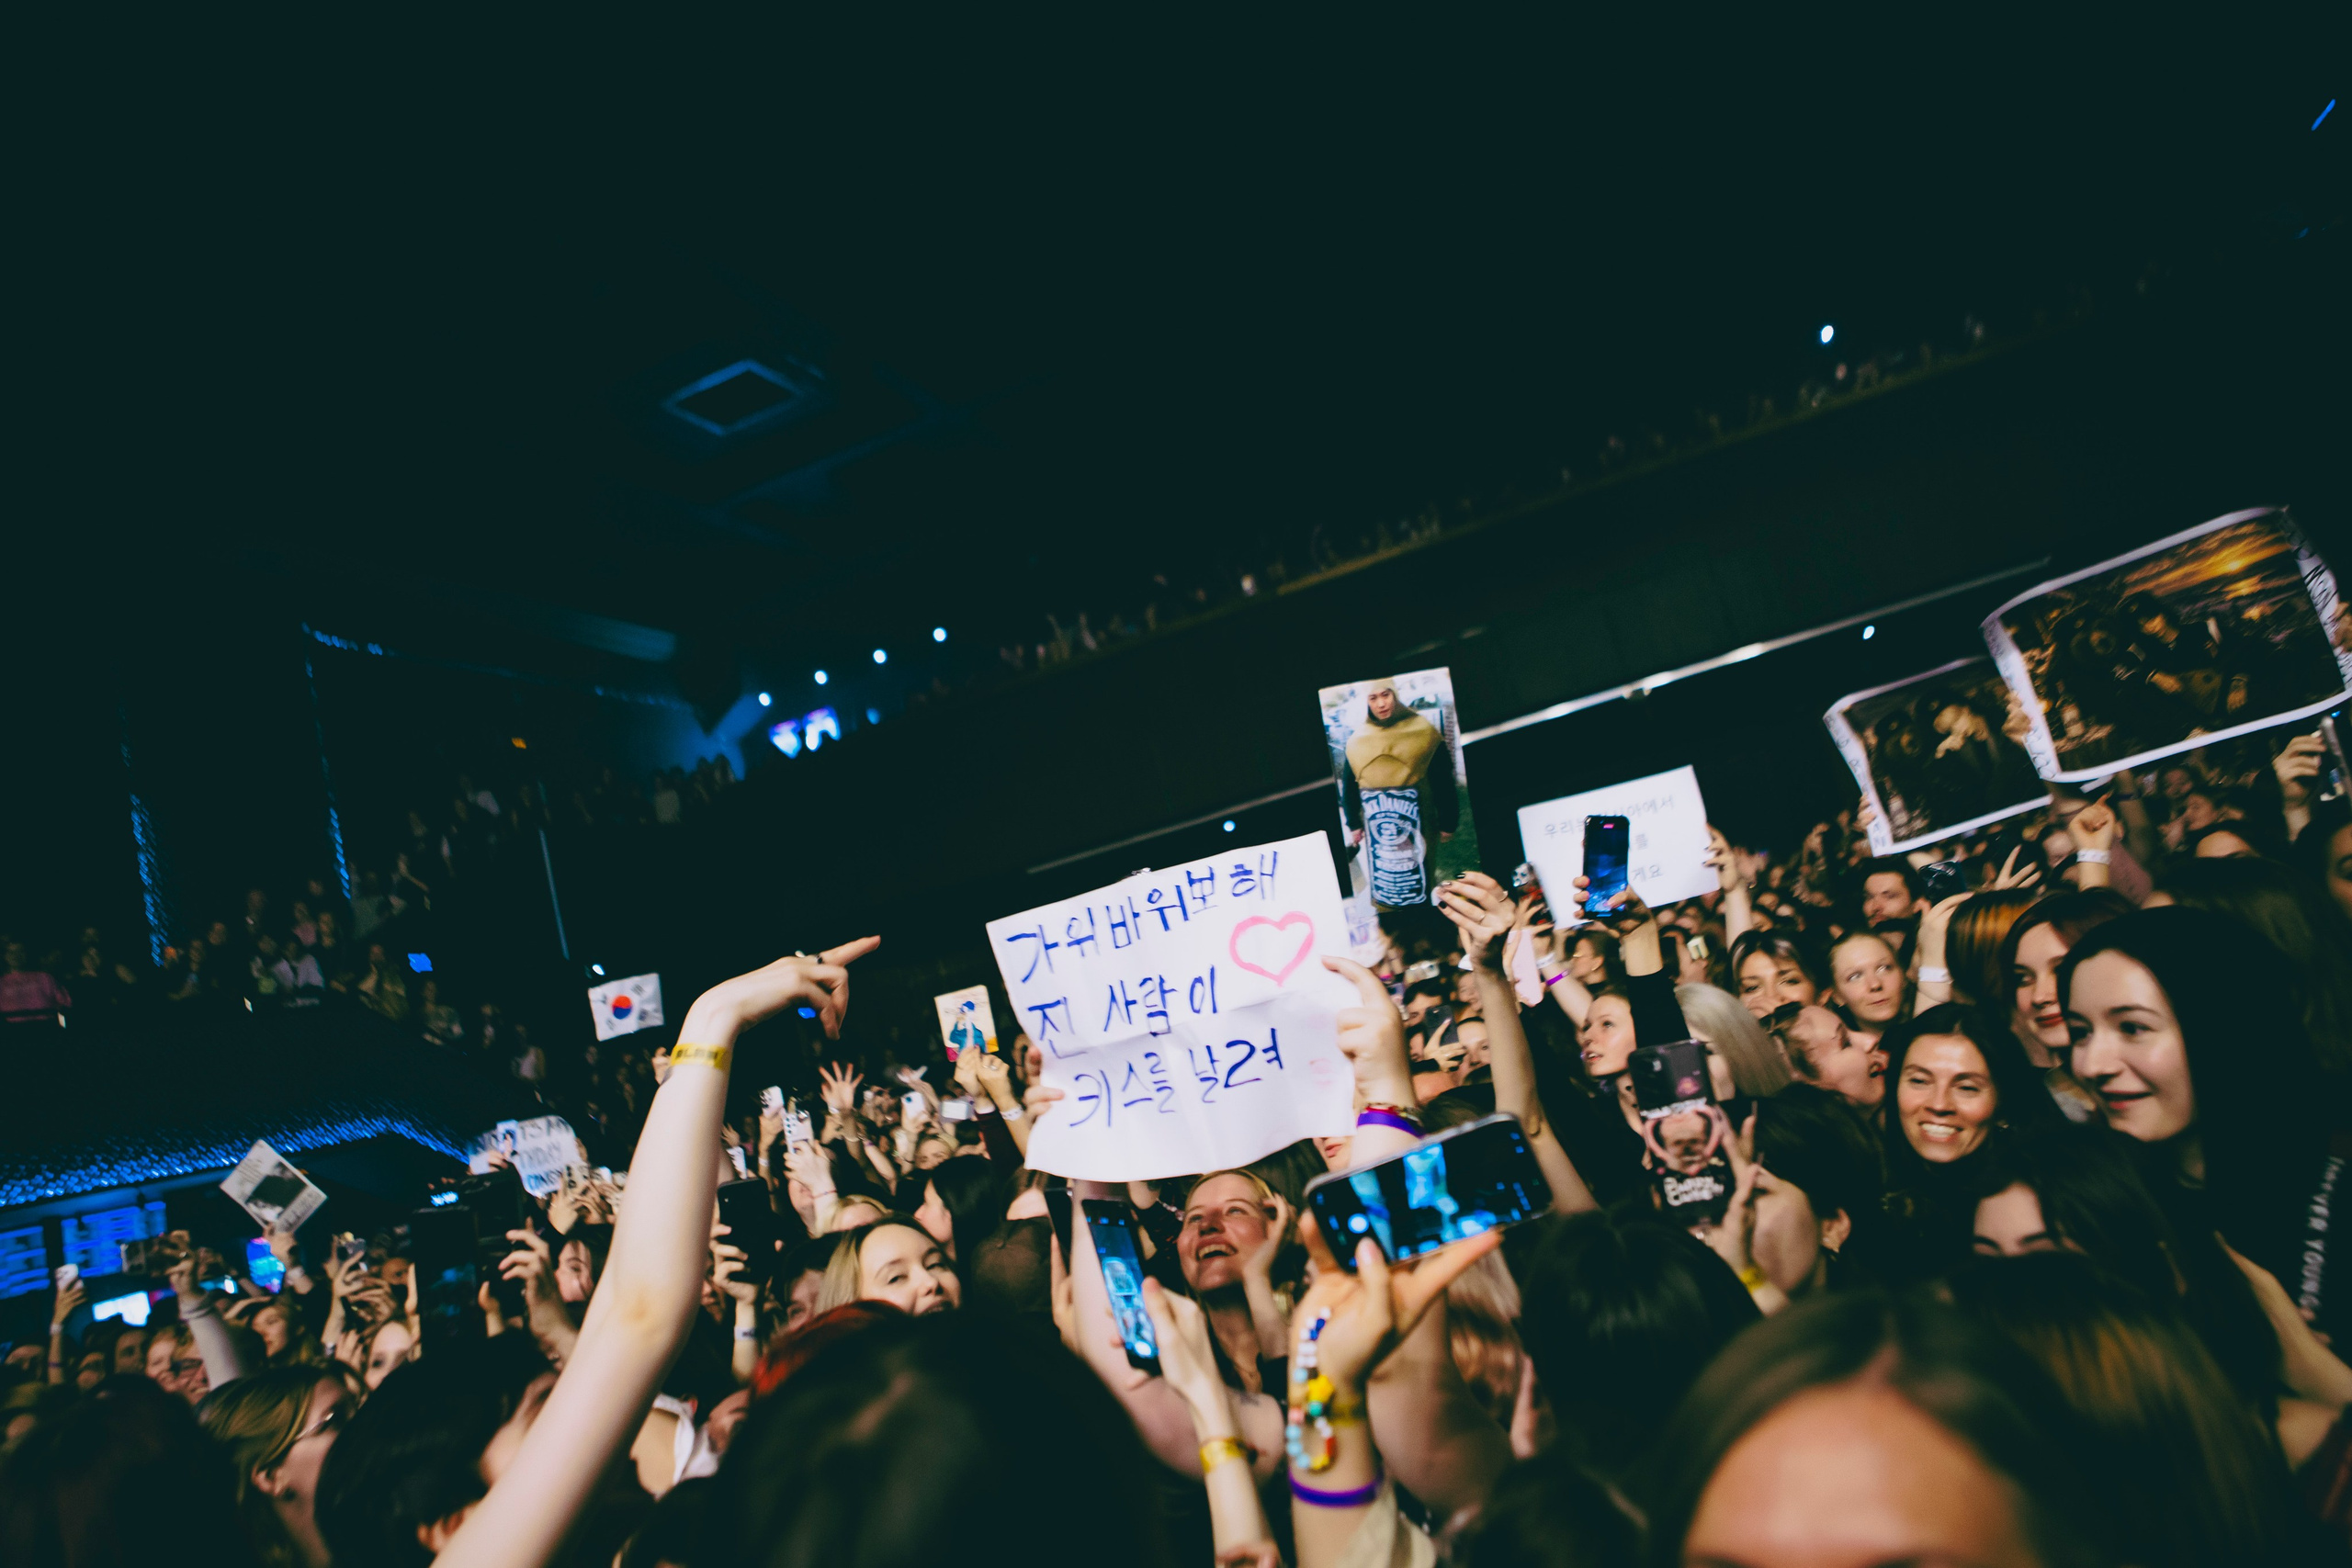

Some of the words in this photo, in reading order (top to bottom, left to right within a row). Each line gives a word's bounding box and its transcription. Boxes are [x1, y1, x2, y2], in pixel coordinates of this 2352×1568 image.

[1632, 864, 1663, 883] 게요
[1027, 997, 1087, 1059] 진
[1103, 975, 1177, 1037] 사람
[1189, 964, 1219, 1014] 이
